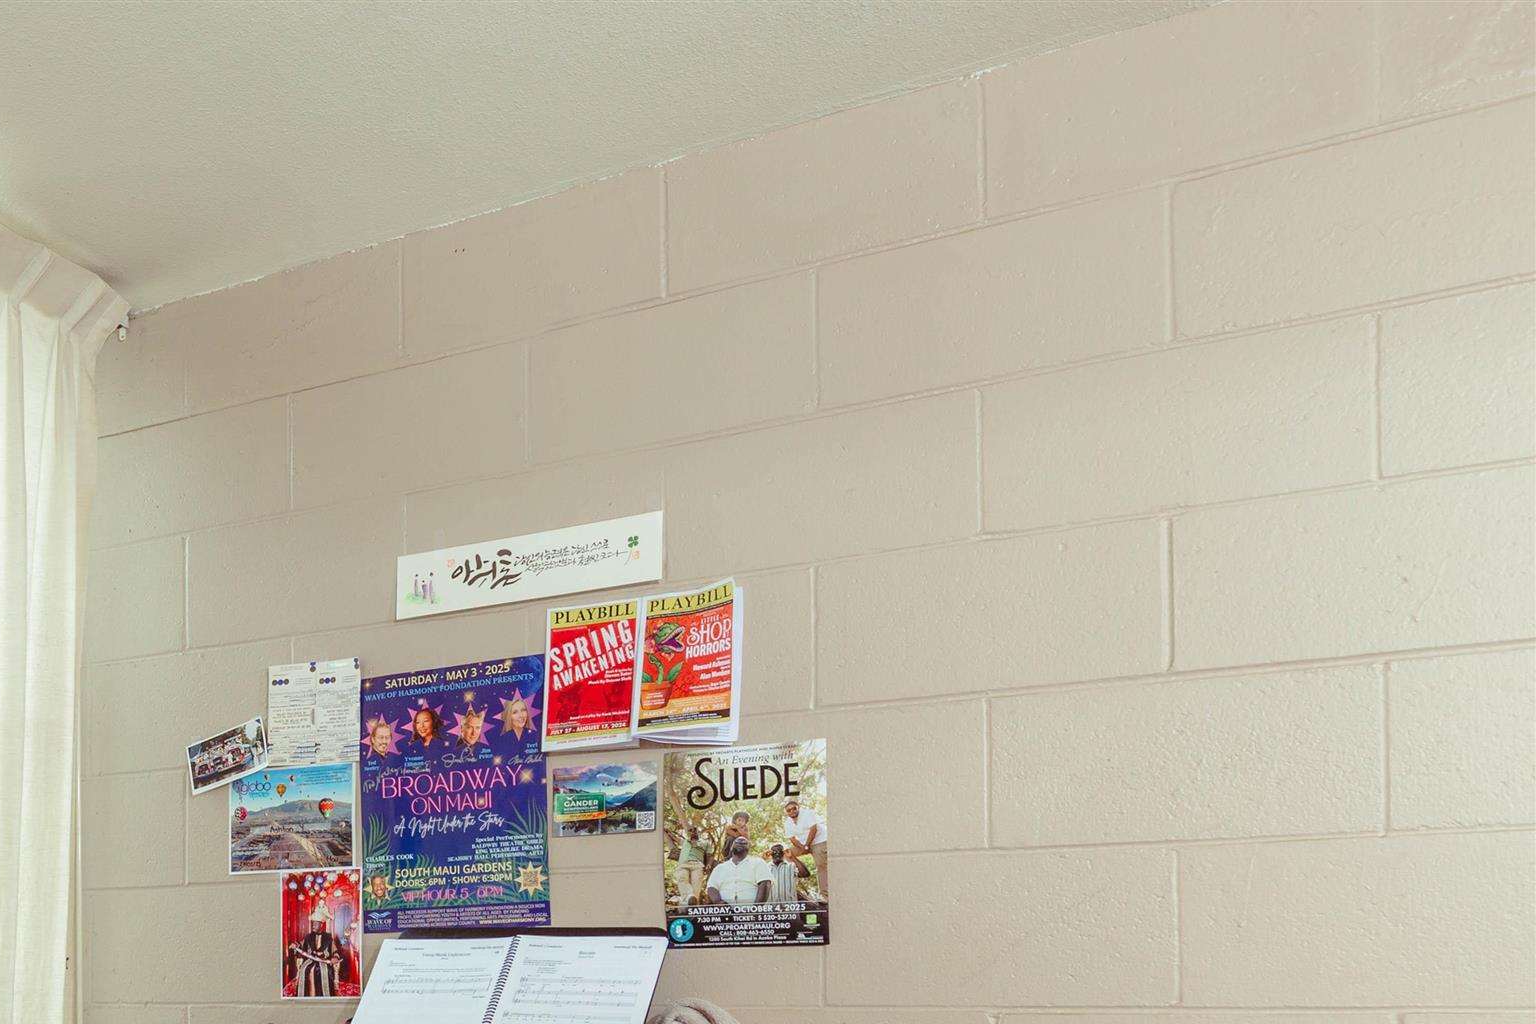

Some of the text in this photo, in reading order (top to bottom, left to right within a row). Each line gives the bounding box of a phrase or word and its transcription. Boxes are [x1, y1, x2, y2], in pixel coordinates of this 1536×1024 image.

[650, 585, 732, 612] PLAYBILL
[555, 603, 634, 624] PLAYBILL
[700, 616, 720, 625] LITTLE
[687, 618, 731, 645] SHOP
[550, 620, 633, 673] SPRING
[686, 638, 731, 659] HORRORS
[552, 644, 635, 691] AWAKENING
[385, 664, 510, 690] SATURDAY MAY 3 2025
[364, 672, 534, 701] WAVE OF HARMONY FOUNDATION PRESENTS
[550, 727, 563, 735] JULY
[576, 724, 600, 732] AUGUST
[714, 755, 729, 766] An
[731, 752, 771, 764] Evening
[772, 750, 794, 761] with
[381, 765, 523, 799] BROADWAY
[686, 757, 800, 810] SUEDE
[411, 790, 493, 816] ON MAUI
[564, 799, 599, 808] GANDER
[270, 825, 294, 833] Ashton
[394, 816, 406, 838] A
[408, 813, 438, 838] Night
[438, 814, 464, 835] Under
[478, 810, 505, 831] Stars
[496, 833, 534, 842] Performances
[490, 852, 527, 860] PERFORMING
[522, 844, 544, 852] DRAMA
[366, 853, 414, 863] CHARLES COOK
[395, 861, 513, 879] SOUTH MAUI GARDENS
[395, 873, 513, 888] DOORS: 6PM SHOW: 6:30PM
[400, 886, 504, 902] VIP 5 6PM
[688, 903, 806, 915] SATURDAY, OCTOBER 4, 2025
[703, 922, 791, 932] WWW.PROARTSMAUI.ORG
